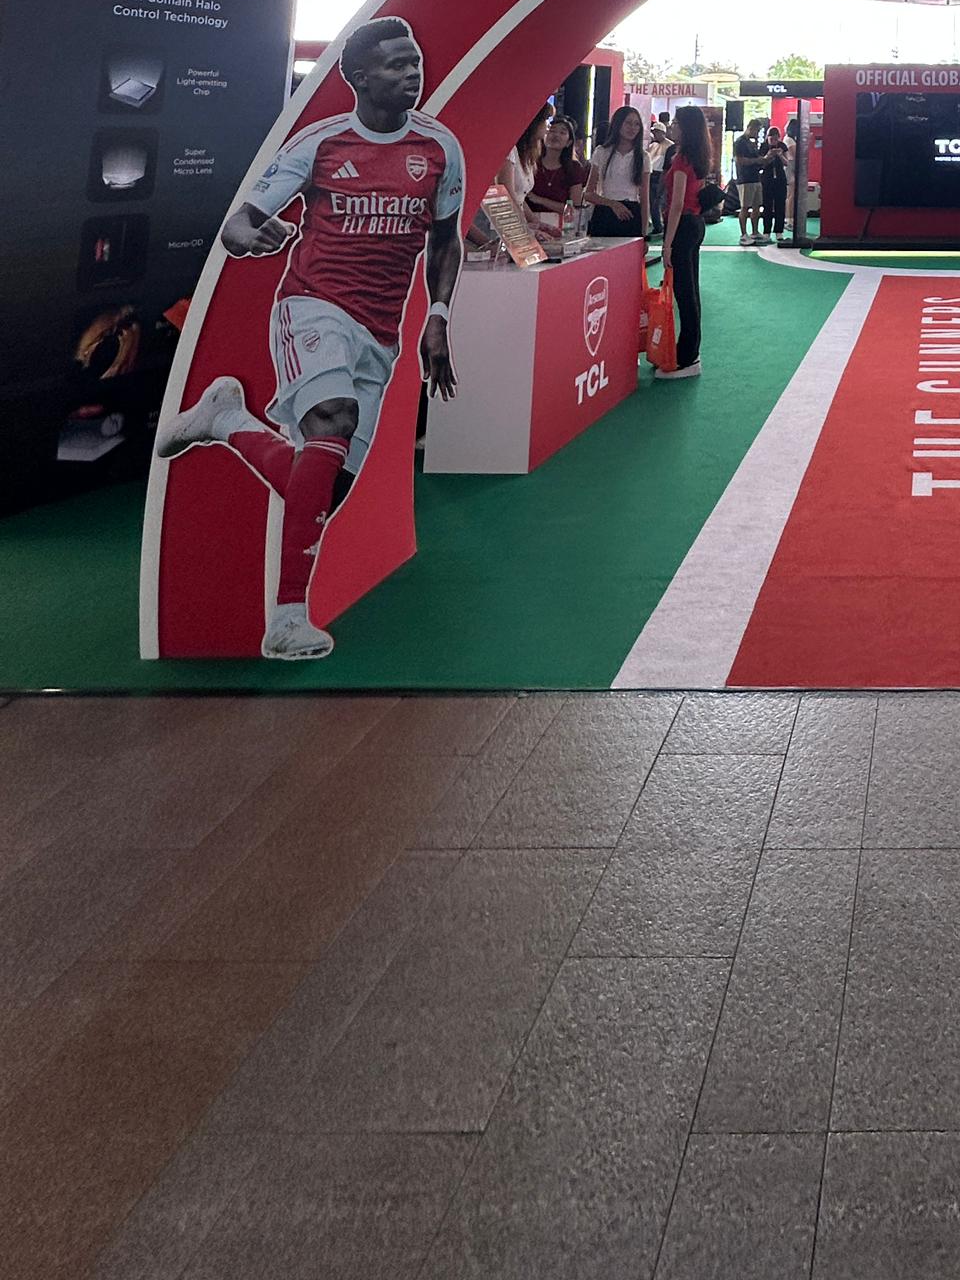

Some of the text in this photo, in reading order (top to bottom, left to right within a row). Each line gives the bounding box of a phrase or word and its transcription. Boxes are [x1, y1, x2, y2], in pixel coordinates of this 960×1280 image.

[113, 5, 229, 29] Control Technology
[187, 68, 220, 78] Powerful
[856, 70, 918, 86] OFFICIAL
[630, 84, 696, 96] THE ARSENAL
[766, 84, 787, 93] TCL
[330, 191, 427, 215] Emirates
[341, 216, 414, 235] FLY BETTER
[575, 360, 609, 405] TCL
